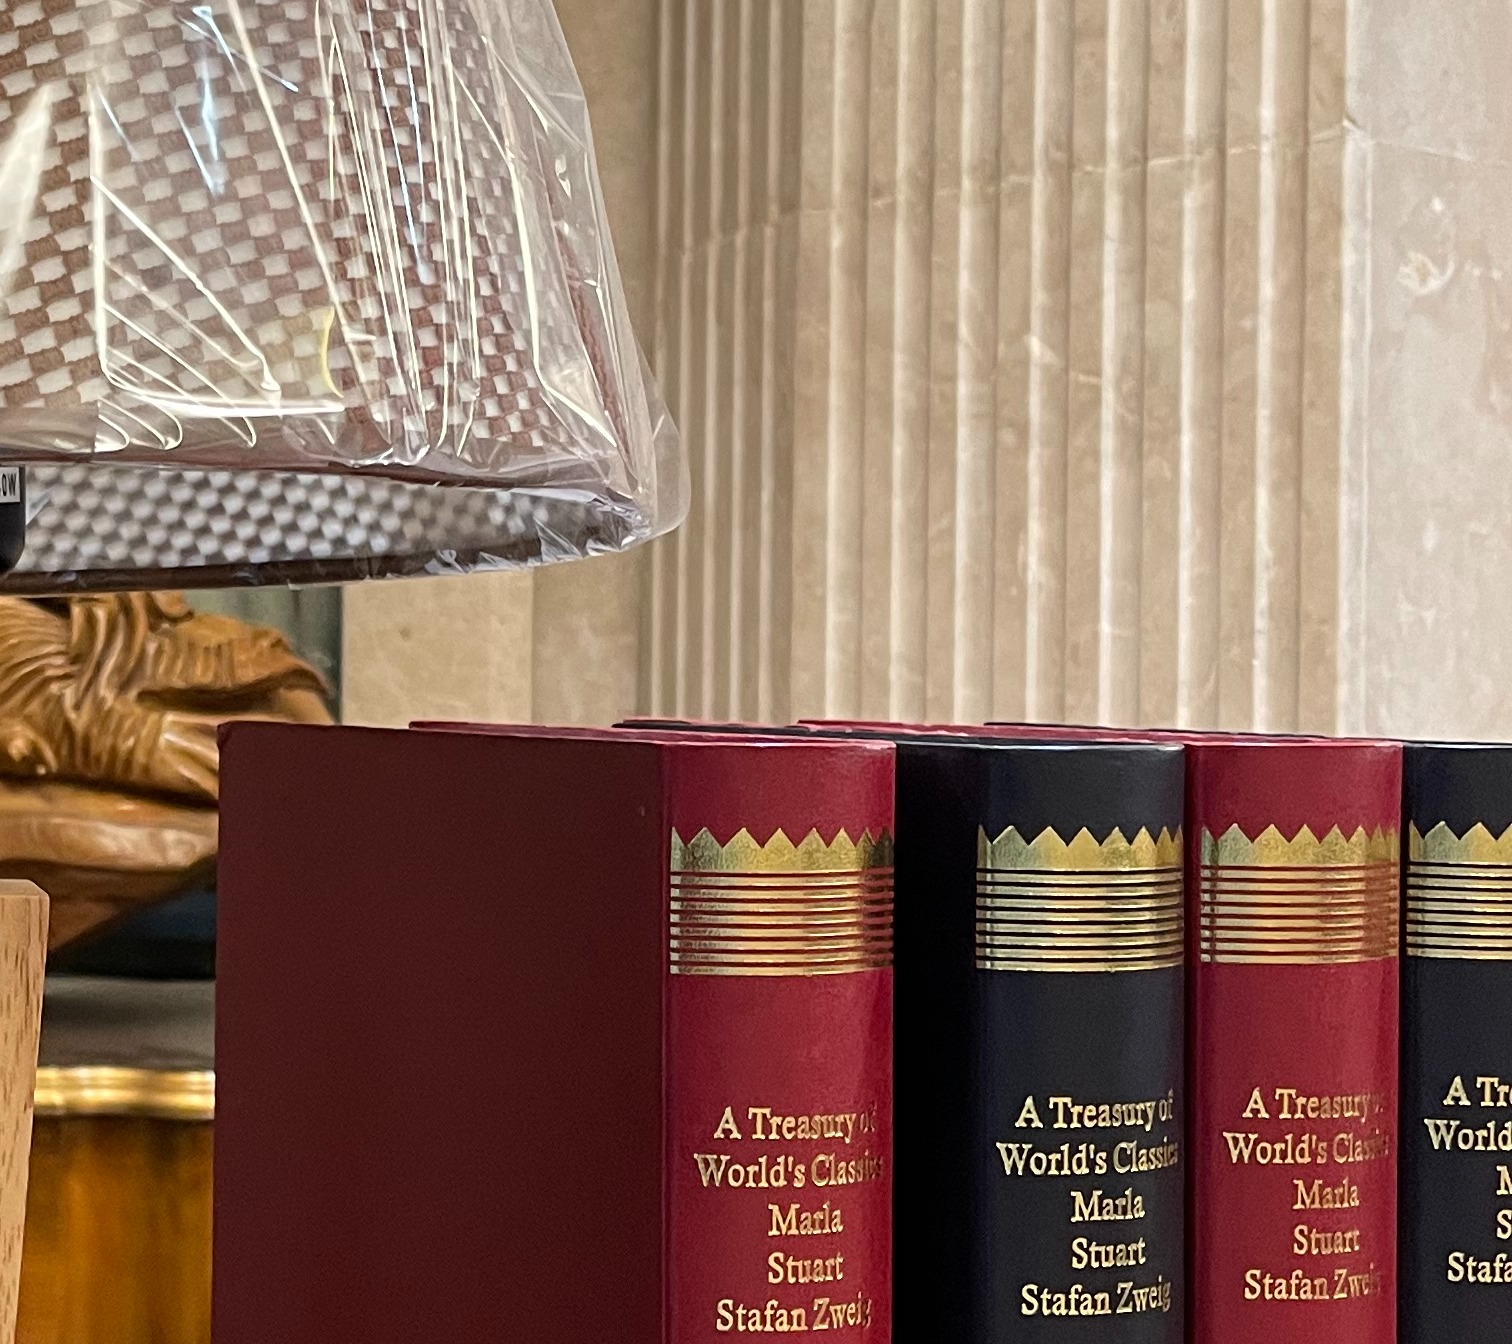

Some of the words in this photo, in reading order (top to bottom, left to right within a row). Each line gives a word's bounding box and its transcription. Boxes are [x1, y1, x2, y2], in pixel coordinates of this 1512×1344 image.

[1241, 1086, 1270, 1120] A
[1274, 1088, 1371, 1124] Treasury
[1442, 1075, 1472, 1107] A
[713, 1106, 742, 1140] A
[747, 1106, 857, 1144] Treasury
[1014, 1095, 1044, 1129] A
[1048, 1096, 1157, 1132] Treasury
[1158, 1087, 1174, 1121] of
[995, 1141, 1108, 1176] World's
[1222, 1131, 1328, 1165] World's
[693, 1152, 807, 1189] World's
[1070, 1187, 1146, 1223] Marla
[1292, 1176, 1360, 1210] Marla
[767, 1201, 844, 1237] Marla
[1070, 1237, 1147, 1270] Stuart
[1293, 1223, 1360, 1256] Stuart
[767, 1251, 844, 1284] Stuart
[1243, 1268, 1330, 1301] Stafan
[1020, 1283, 1112, 1316] Stafan
[1115, 1274, 1172, 1314] Zweig
[715, 1298, 808, 1332] Stafan
